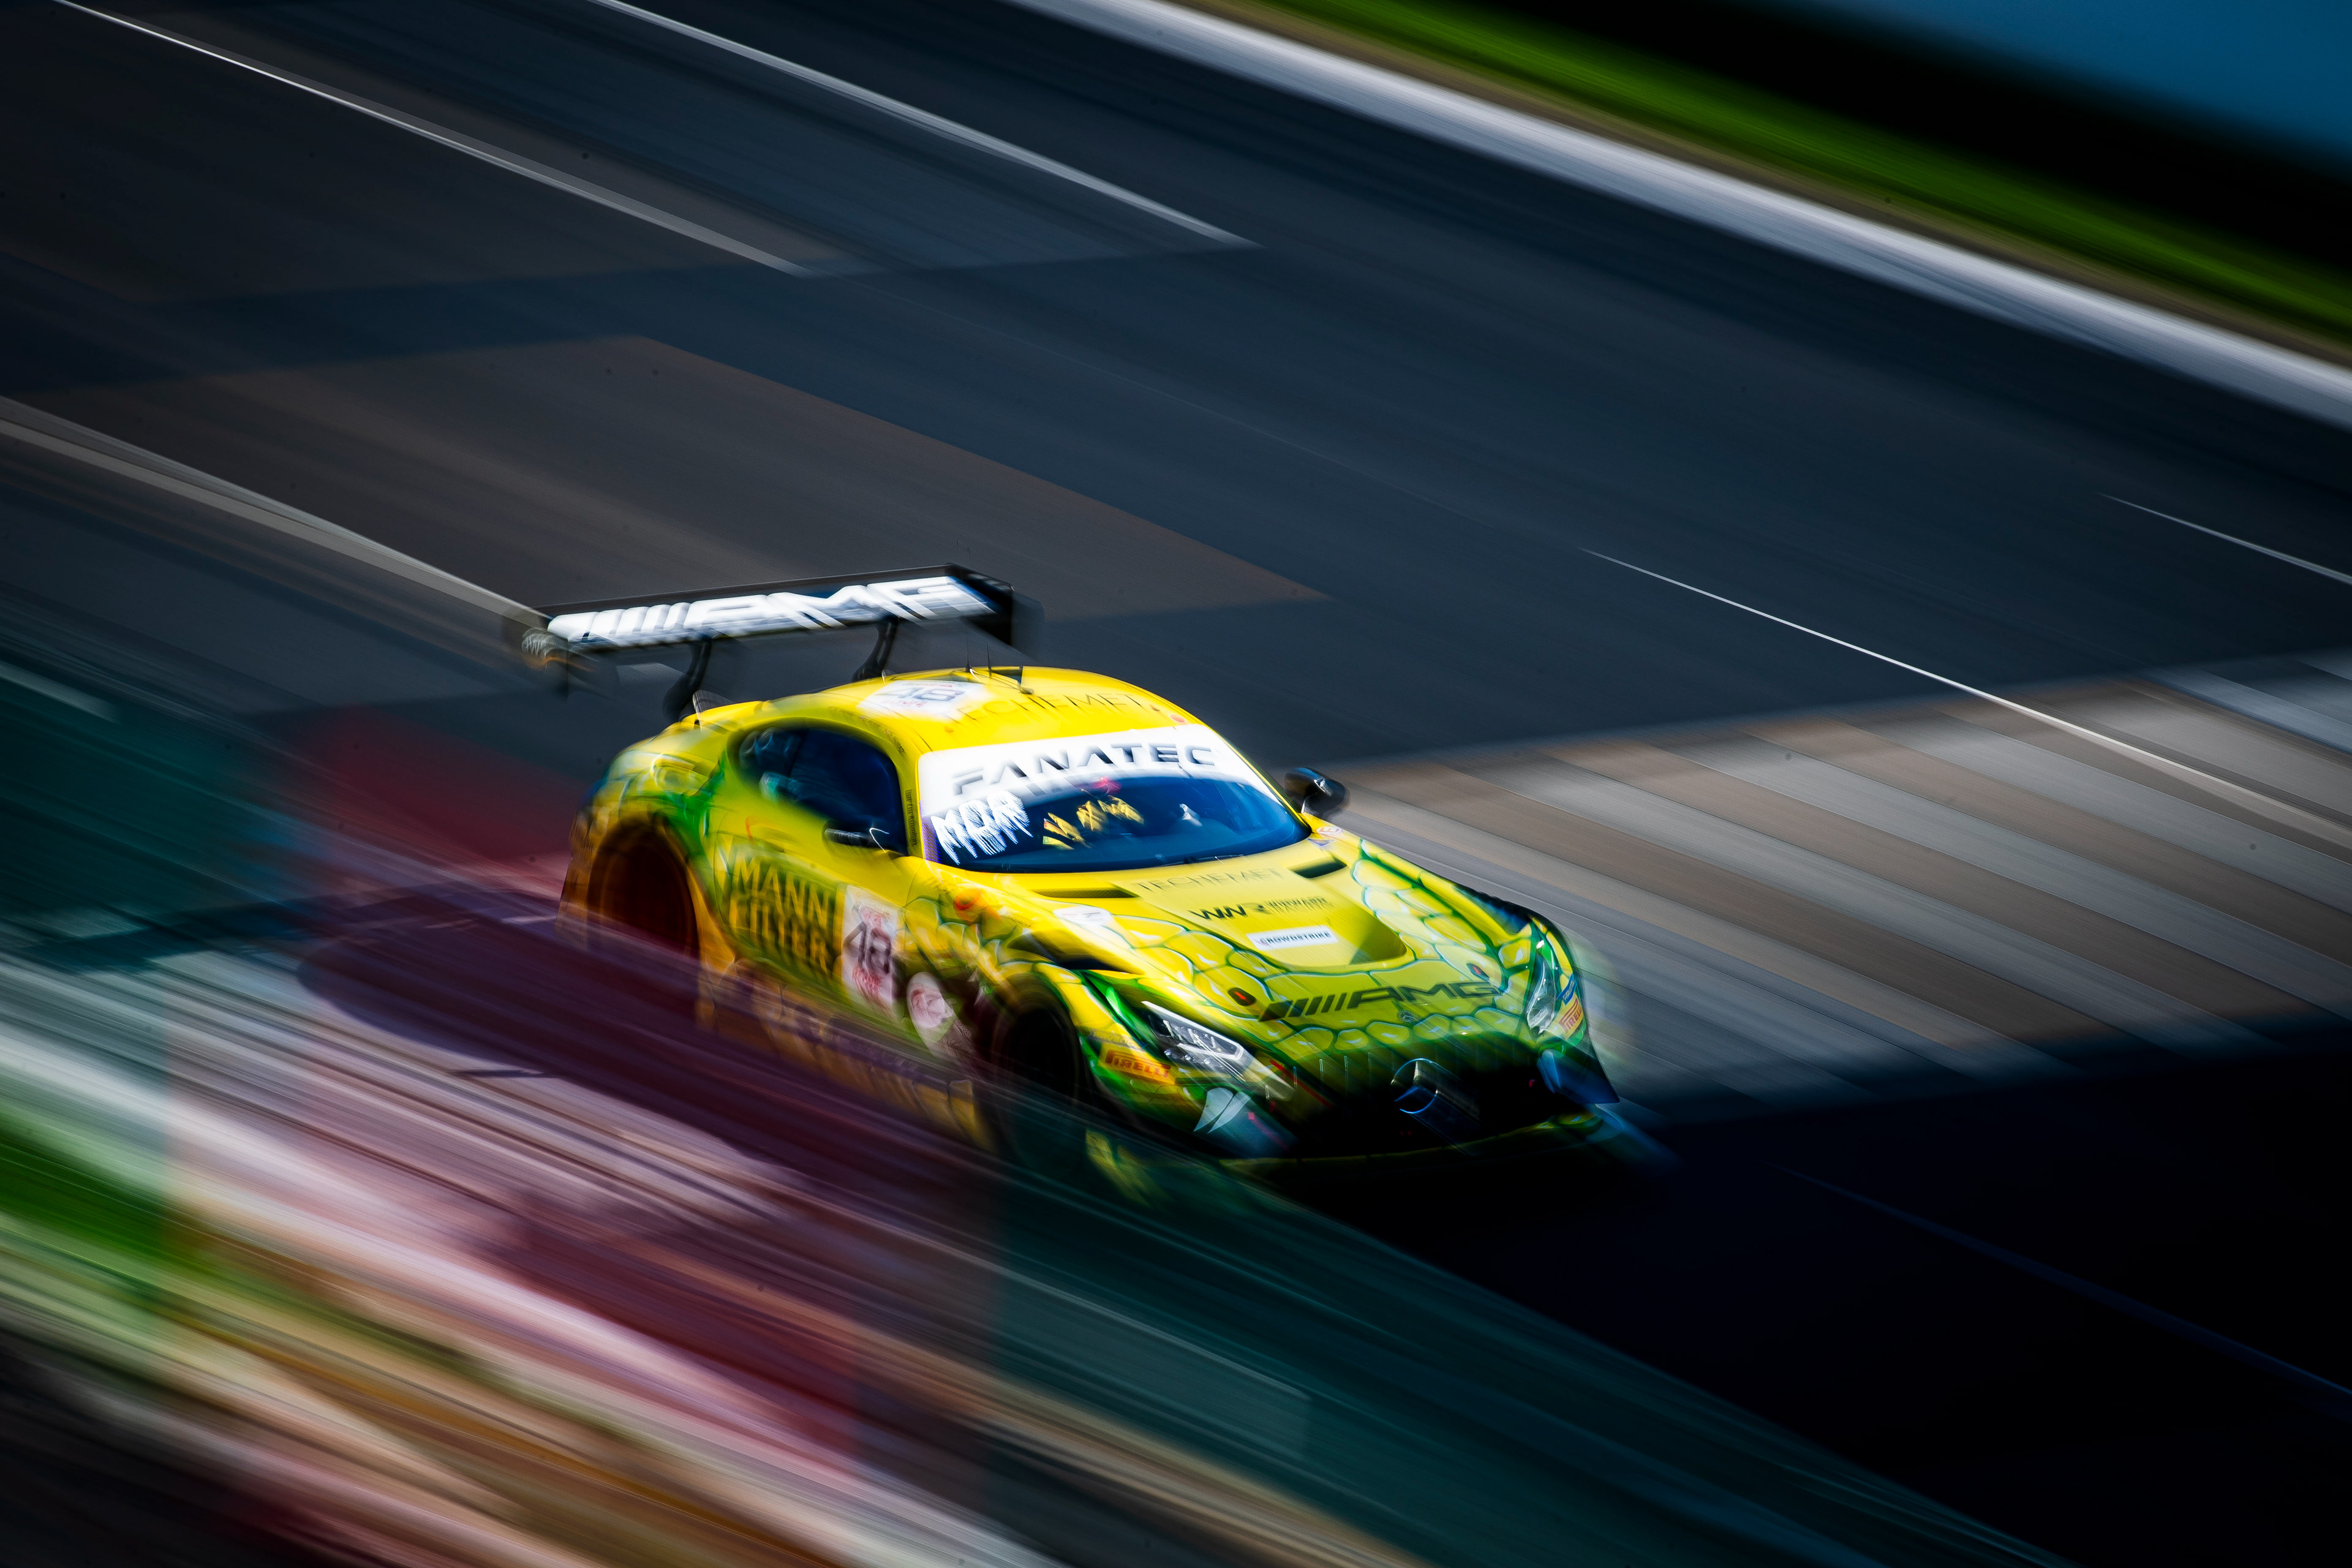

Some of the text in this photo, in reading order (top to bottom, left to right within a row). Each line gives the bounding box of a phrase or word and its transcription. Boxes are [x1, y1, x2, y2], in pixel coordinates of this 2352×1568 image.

[951, 742, 1216, 796] FANATEC
[732, 855, 830, 932] MANN
[1134, 867, 1284, 892] TECHEMET
[1258, 930, 1332, 945] CROWDSTRIKE
[1104, 1049, 1171, 1078] PIRELLI
